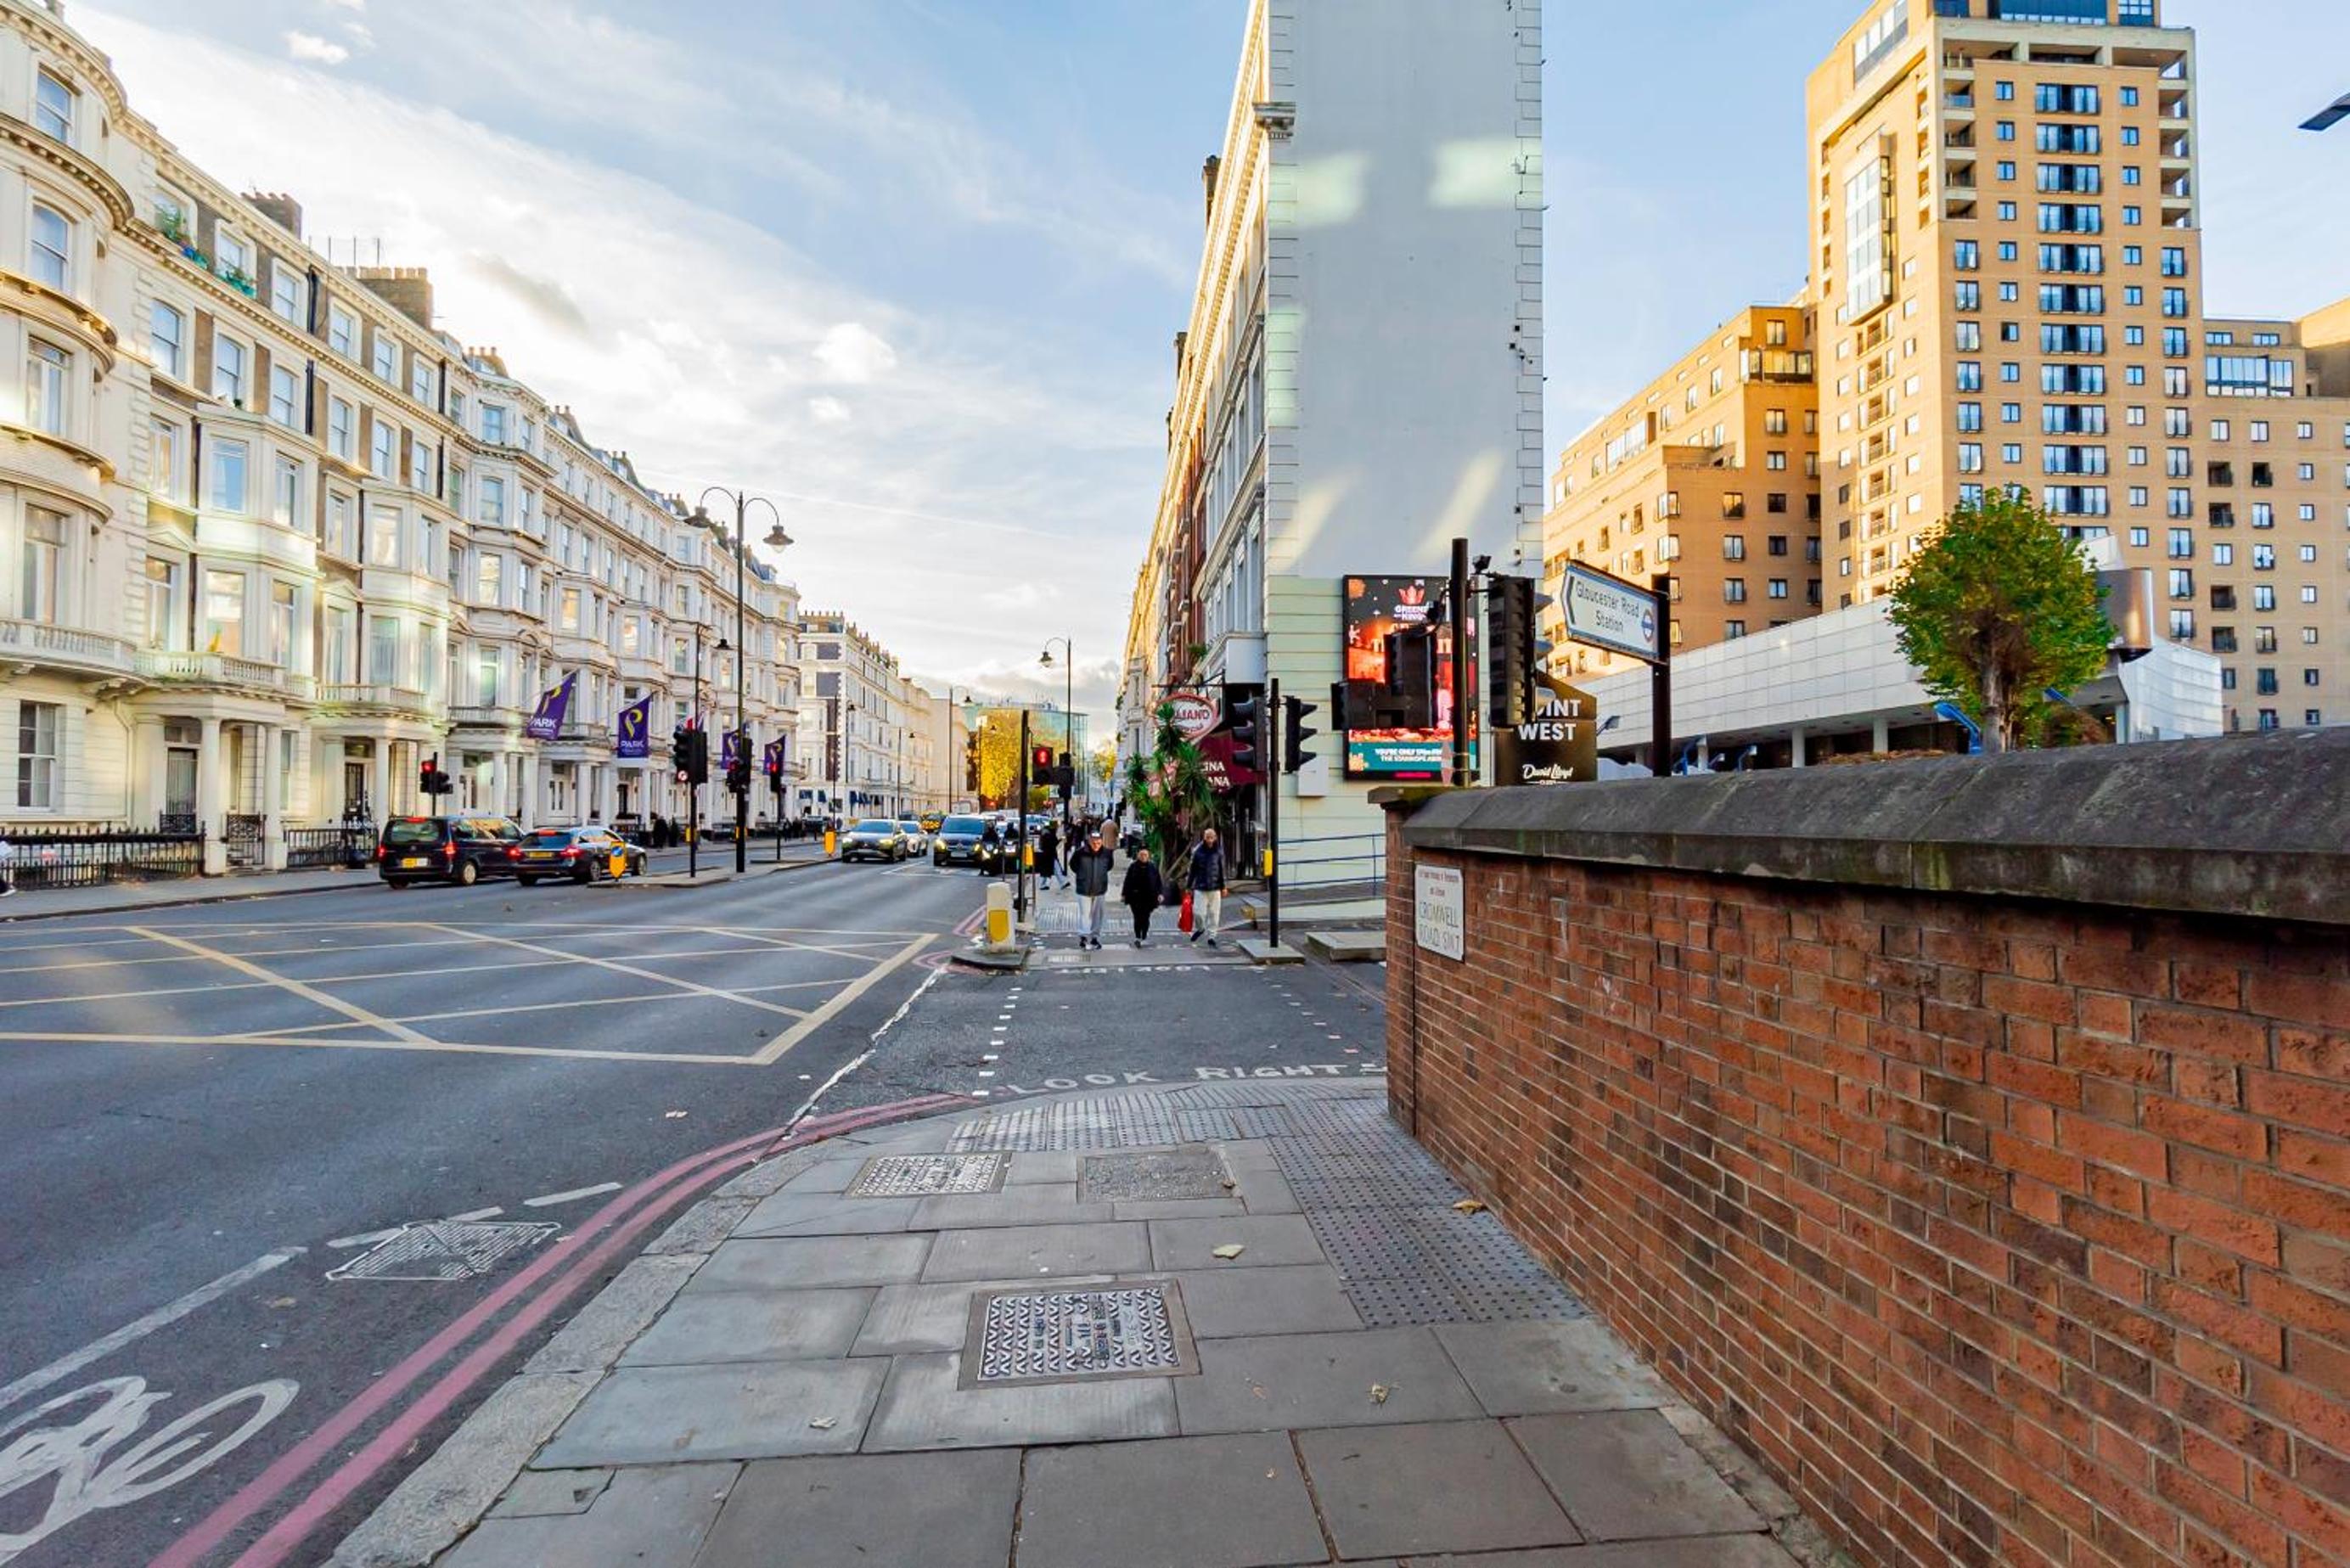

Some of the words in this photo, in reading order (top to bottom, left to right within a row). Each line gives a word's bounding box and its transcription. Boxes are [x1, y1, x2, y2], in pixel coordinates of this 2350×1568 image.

[1577, 581, 1618, 609] Gloucester
[1621, 597, 1639, 618] Road
[1596, 610, 1623, 632] Station
[1518, 722, 1577, 741] WEST
[1522, 764, 1551, 779] David
[1551, 763, 1574, 779] Lloyd
[1419, 902, 1459, 928] CROMWELL
[1419, 923, 1441, 947] ROAD
[1005, 1071, 1161, 1096] LOOK
[1195, 1064, 1348, 1080] RIGHT
